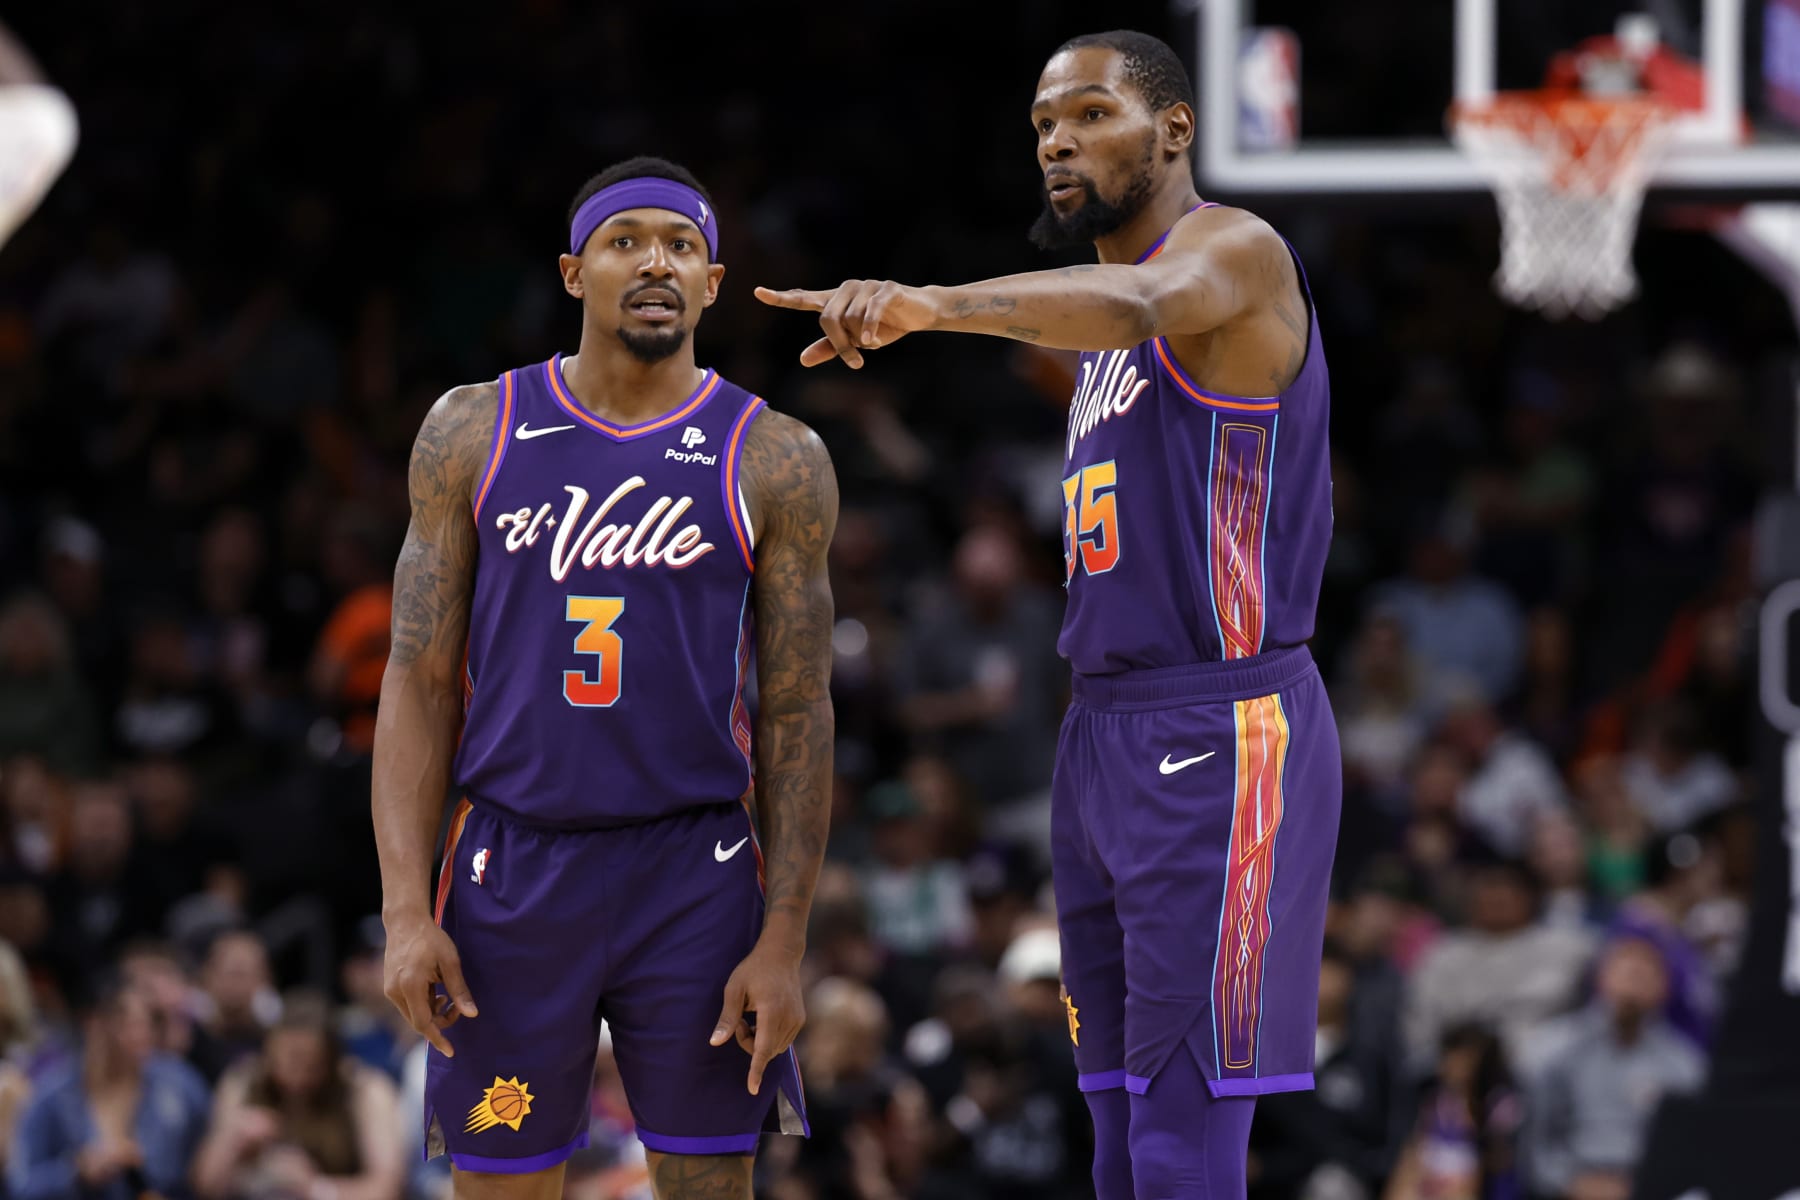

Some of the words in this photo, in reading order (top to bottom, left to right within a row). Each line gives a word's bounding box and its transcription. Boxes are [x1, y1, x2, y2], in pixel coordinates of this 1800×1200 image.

[664, 448, 717, 466] PayPal
[496, 503, 551, 553] El
[550, 476, 715, 583] Valle
[1062, 459, 1120, 588] 35
[563, 595, 625, 707] 3
